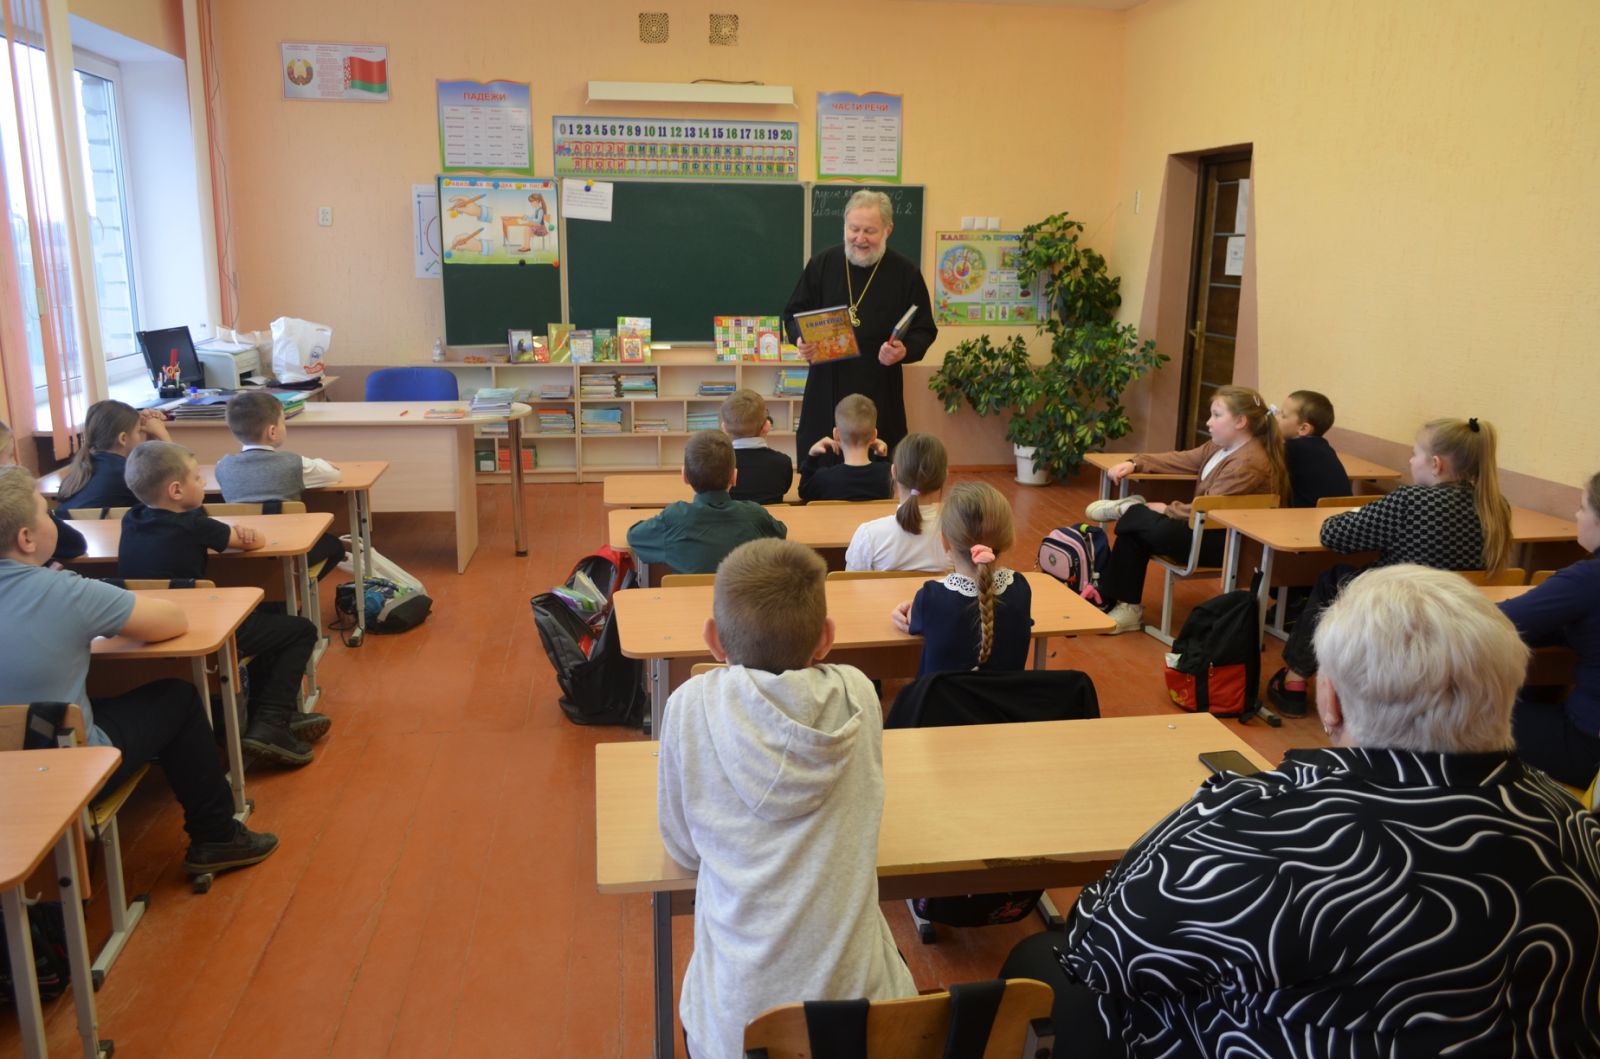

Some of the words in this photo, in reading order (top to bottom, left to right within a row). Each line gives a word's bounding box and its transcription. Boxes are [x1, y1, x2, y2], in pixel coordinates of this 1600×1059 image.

[463, 92, 507, 101] ПАДЕЖИ
[832, 103, 862, 111] ЧАСТИ
[864, 104, 889, 112] РЕЧИ
[560, 124, 566, 134] 0
[569, 125, 573, 135] 1
[577, 125, 583, 135] 2
[585, 125, 591, 135] 3
[594, 125, 599, 135] 4
[602, 125, 607, 135] 5
[610, 125, 616, 135] 6
[619, 125, 624, 135] 7
[627, 126, 633, 136] 8
[635, 126, 641, 136] 9
[644, 126, 655, 136] 10
[658, 126, 666, 137] 11
[671, 127, 681, 137] 12
[685, 127, 695, 137] 13
[699, 128, 709, 138] 14
[713, 128, 723, 138] 15
[726, 128, 737, 139] 16
[740, 129, 751, 139] 17
[754, 129, 764, 139] 18
[768, 129, 778, 139] 19
[781, 129, 792, 140] 20
